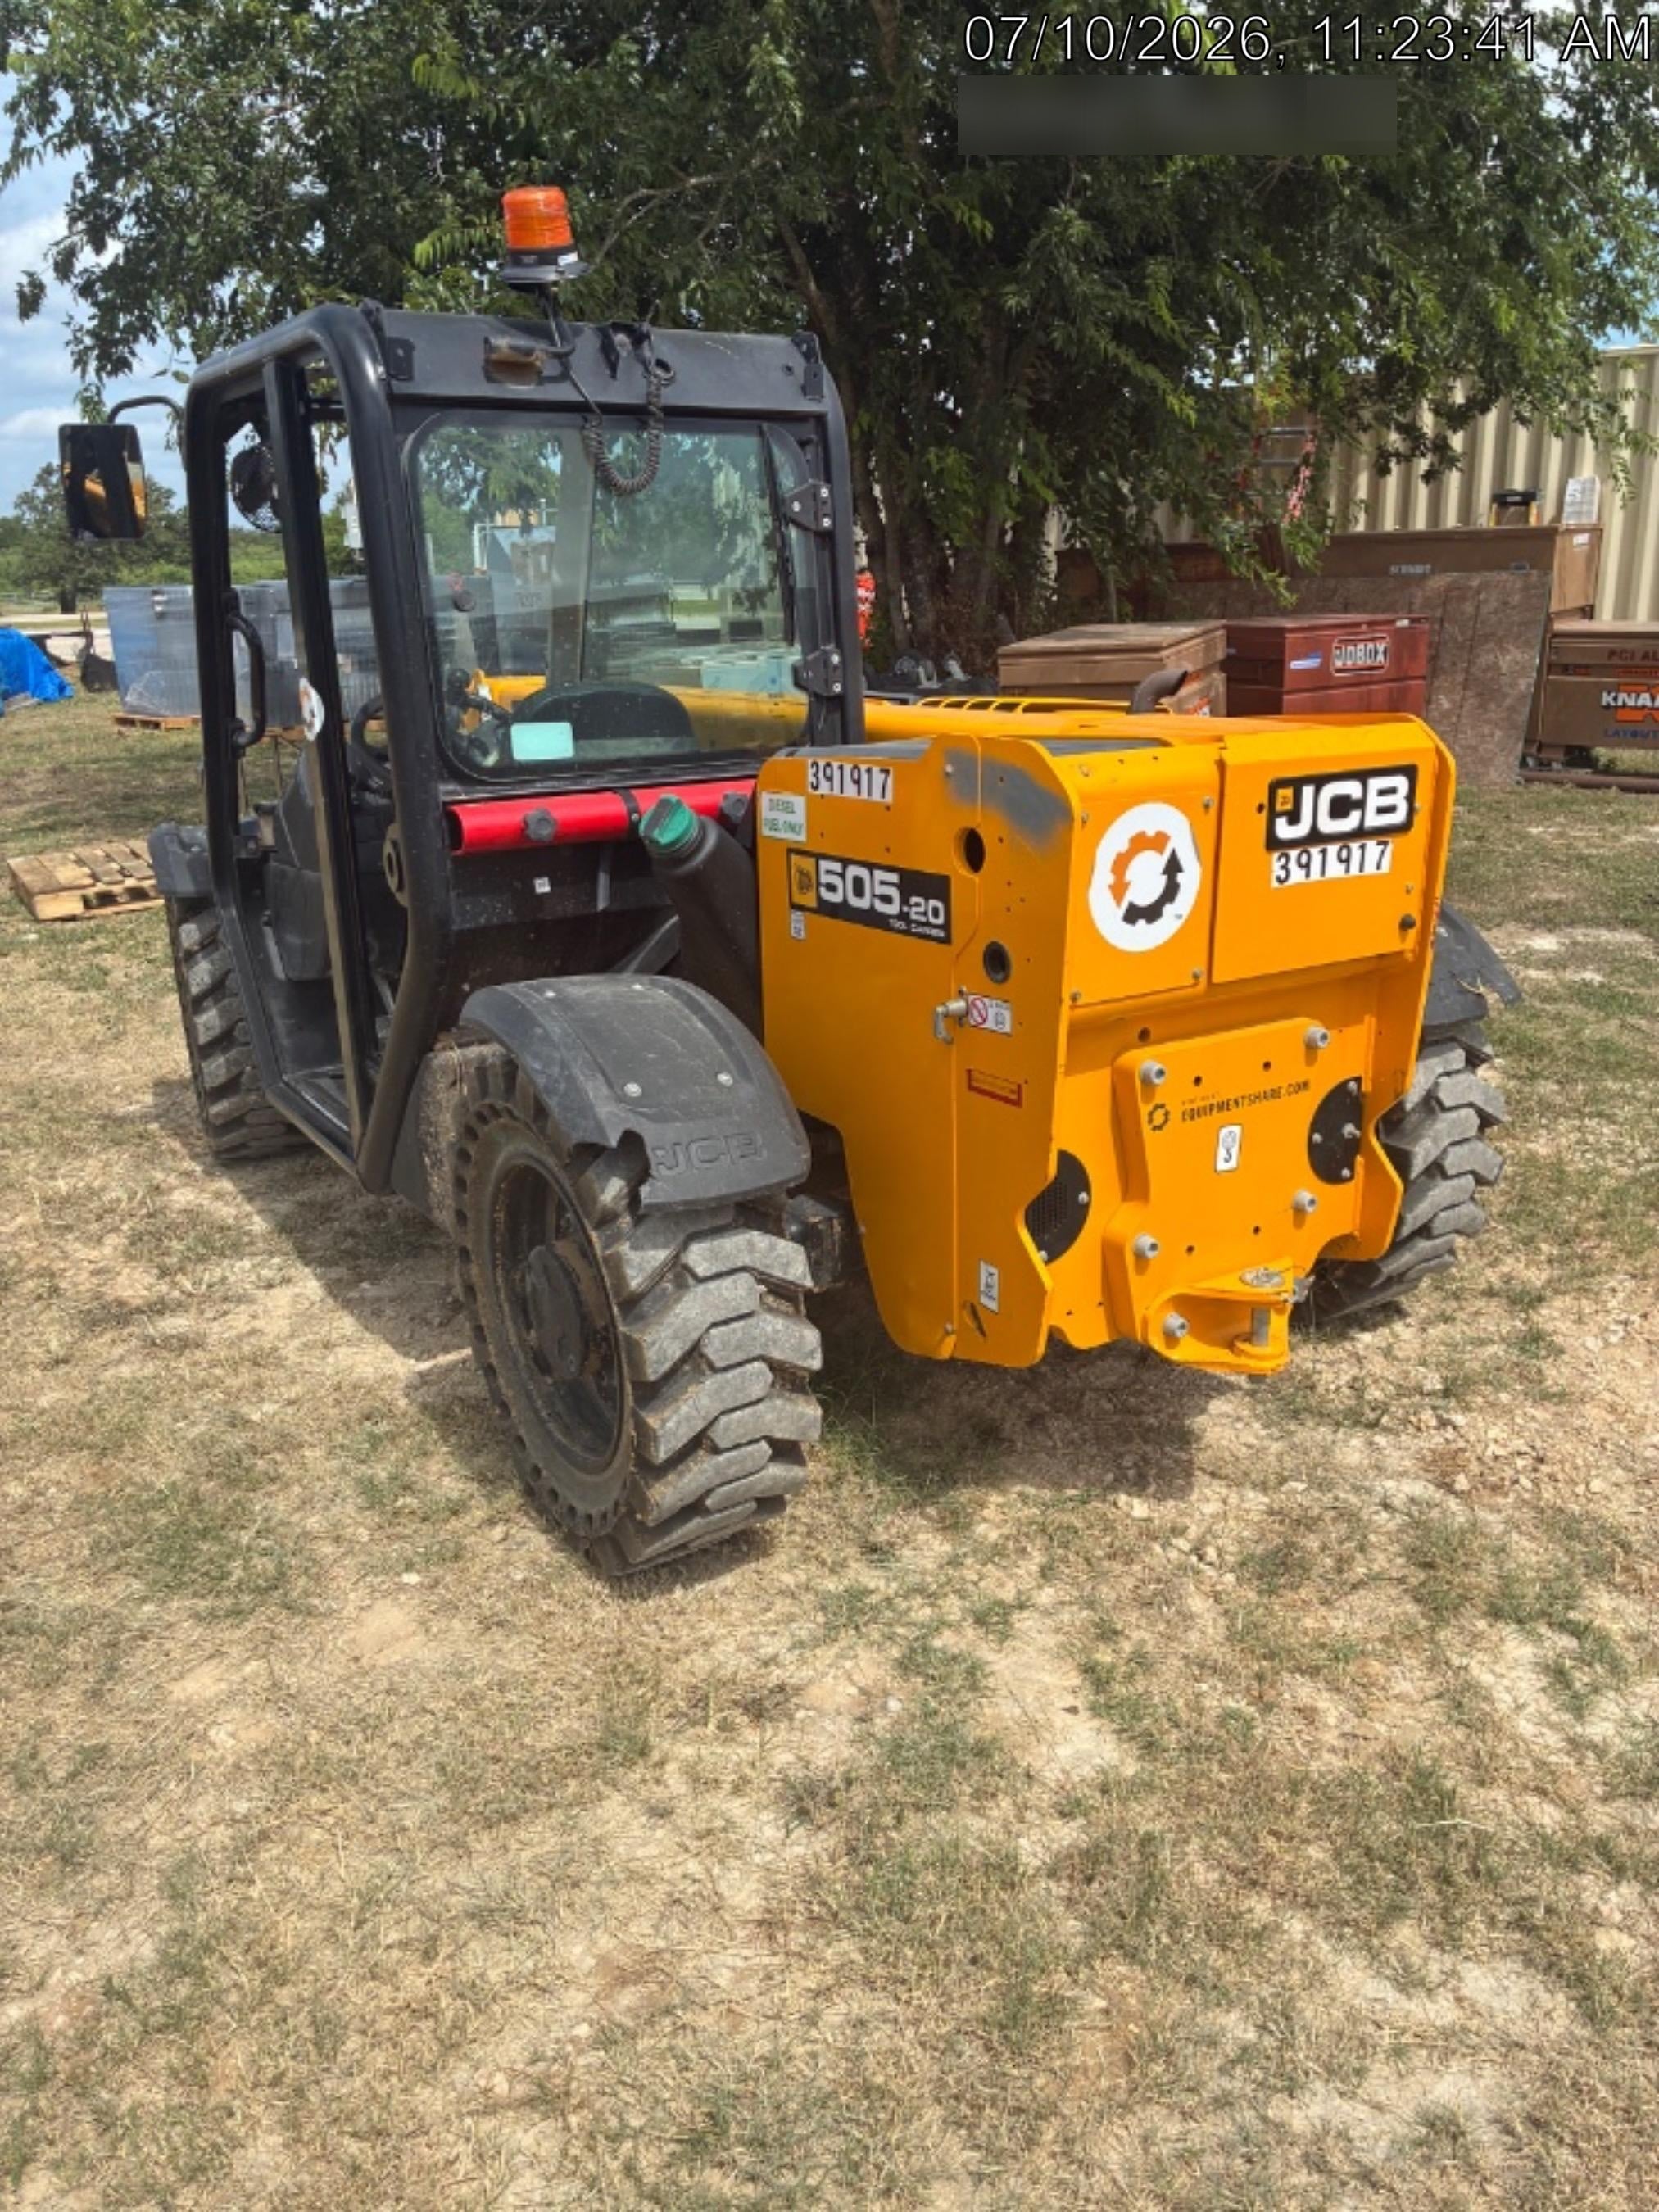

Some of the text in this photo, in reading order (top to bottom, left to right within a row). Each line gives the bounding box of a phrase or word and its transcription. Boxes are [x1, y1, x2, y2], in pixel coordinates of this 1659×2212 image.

[1334, 641, 1386, 667] JOBOX
[809, 760, 891, 800] 391917
[1274, 774, 1410, 841] JCB
[1275, 840, 1390, 886] 391917
[1181, 1079, 1310, 1122] EQUIPMENTSHARE.COM
